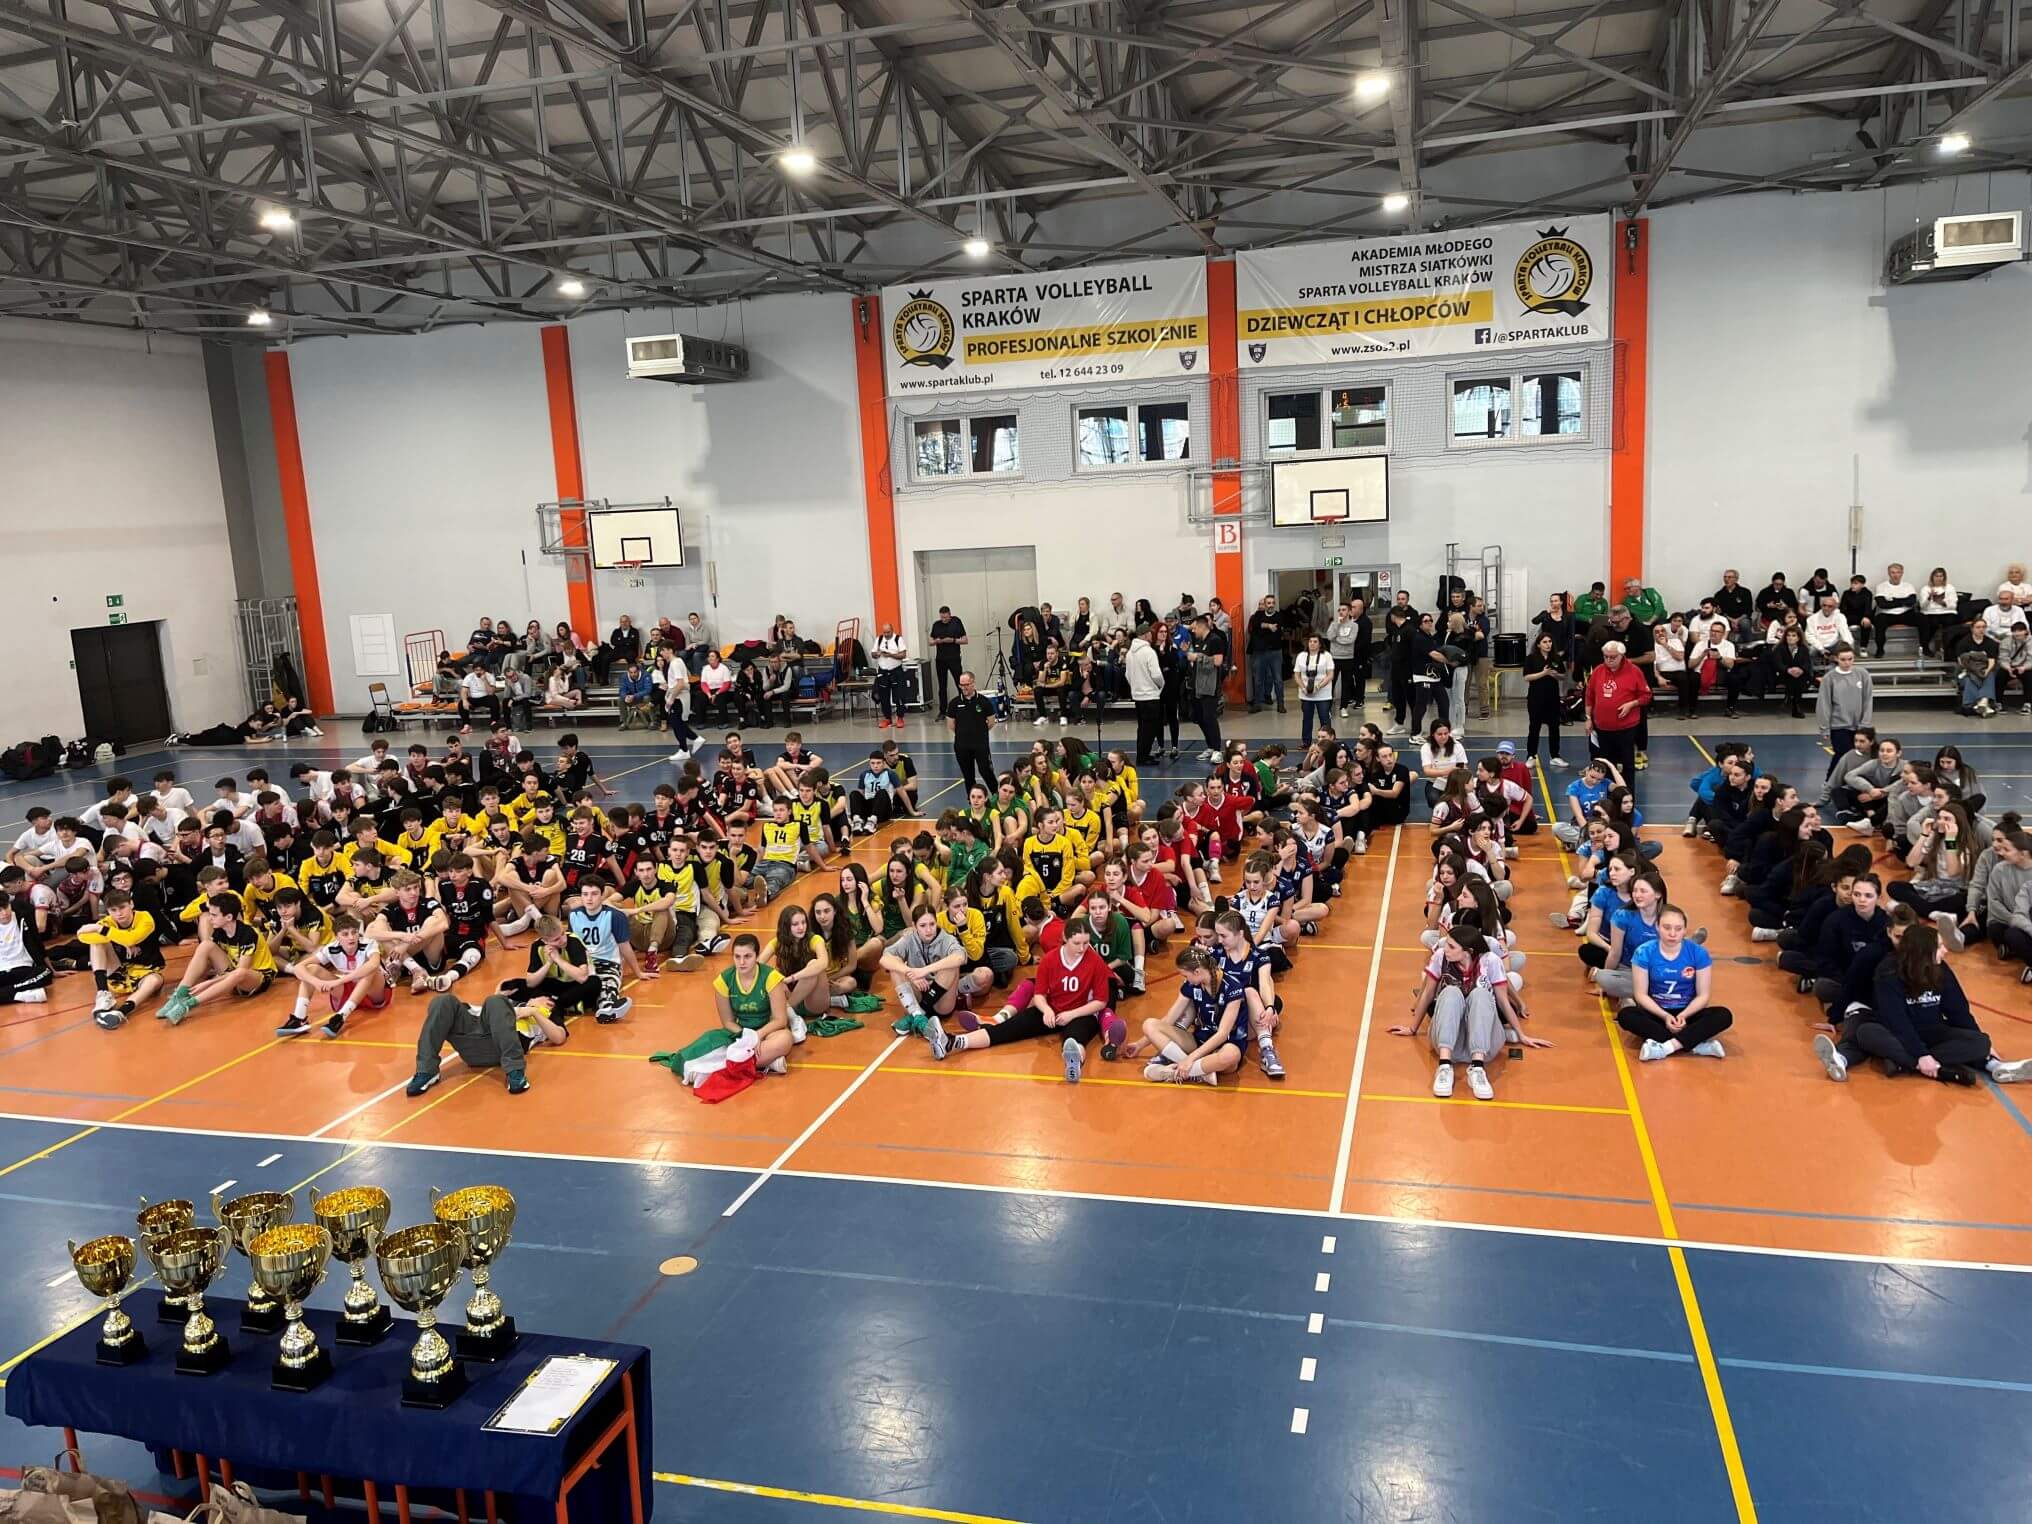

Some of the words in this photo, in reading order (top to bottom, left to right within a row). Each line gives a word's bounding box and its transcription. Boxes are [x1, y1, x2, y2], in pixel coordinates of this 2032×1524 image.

[1351, 245, 1422, 262] AKADEMIA
[1425, 237, 1494, 255] MŁODEGO
[1359, 262, 1417, 278] MISTRZA
[1420, 254, 1494, 273] SIATKÓWKI
[961, 286, 1028, 308] SPARTA
[1035, 275, 1153, 301] VOLLEYBALL
[1298, 283, 1346, 299] SPARTA
[1349, 277, 1431, 296] VOLLEYBALL
[1434, 270, 1494, 288] KRAKÓW
[962, 307, 1042, 330] KRAKÓW
[1247, 311, 1351, 334] DZIEWCZĄT
[1354, 310, 1360, 325] I
[1364, 300, 1471, 325] CHŁOPCÓW
[967, 332, 1101, 358] PROFESJONALNE
[1107, 323, 1198, 346] SZKOLENIE
[1040, 370, 1057, 380] tel.
[1059, 367, 1072, 378] 12
[1074, 366, 1094, 377] 644
[1096, 365, 1109, 376] 23
[1111, 364, 1124, 375] 09
[900, 373, 994, 390] www.spartaklub.pl
[1220, 524, 1237, 545] B
[774, 830, 787, 843] 14
[570, 849, 586, 862] 28
[1042, 864, 1049, 877] 5
[1249, 910, 1256, 923] 8
[582, 926, 600, 945] 20
[1093, 943, 1110, 957] 10
[1061, 975, 1079, 992] 10
[1663, 980, 1678, 994] 7
[1207, 1010, 1215, 1022] 7
